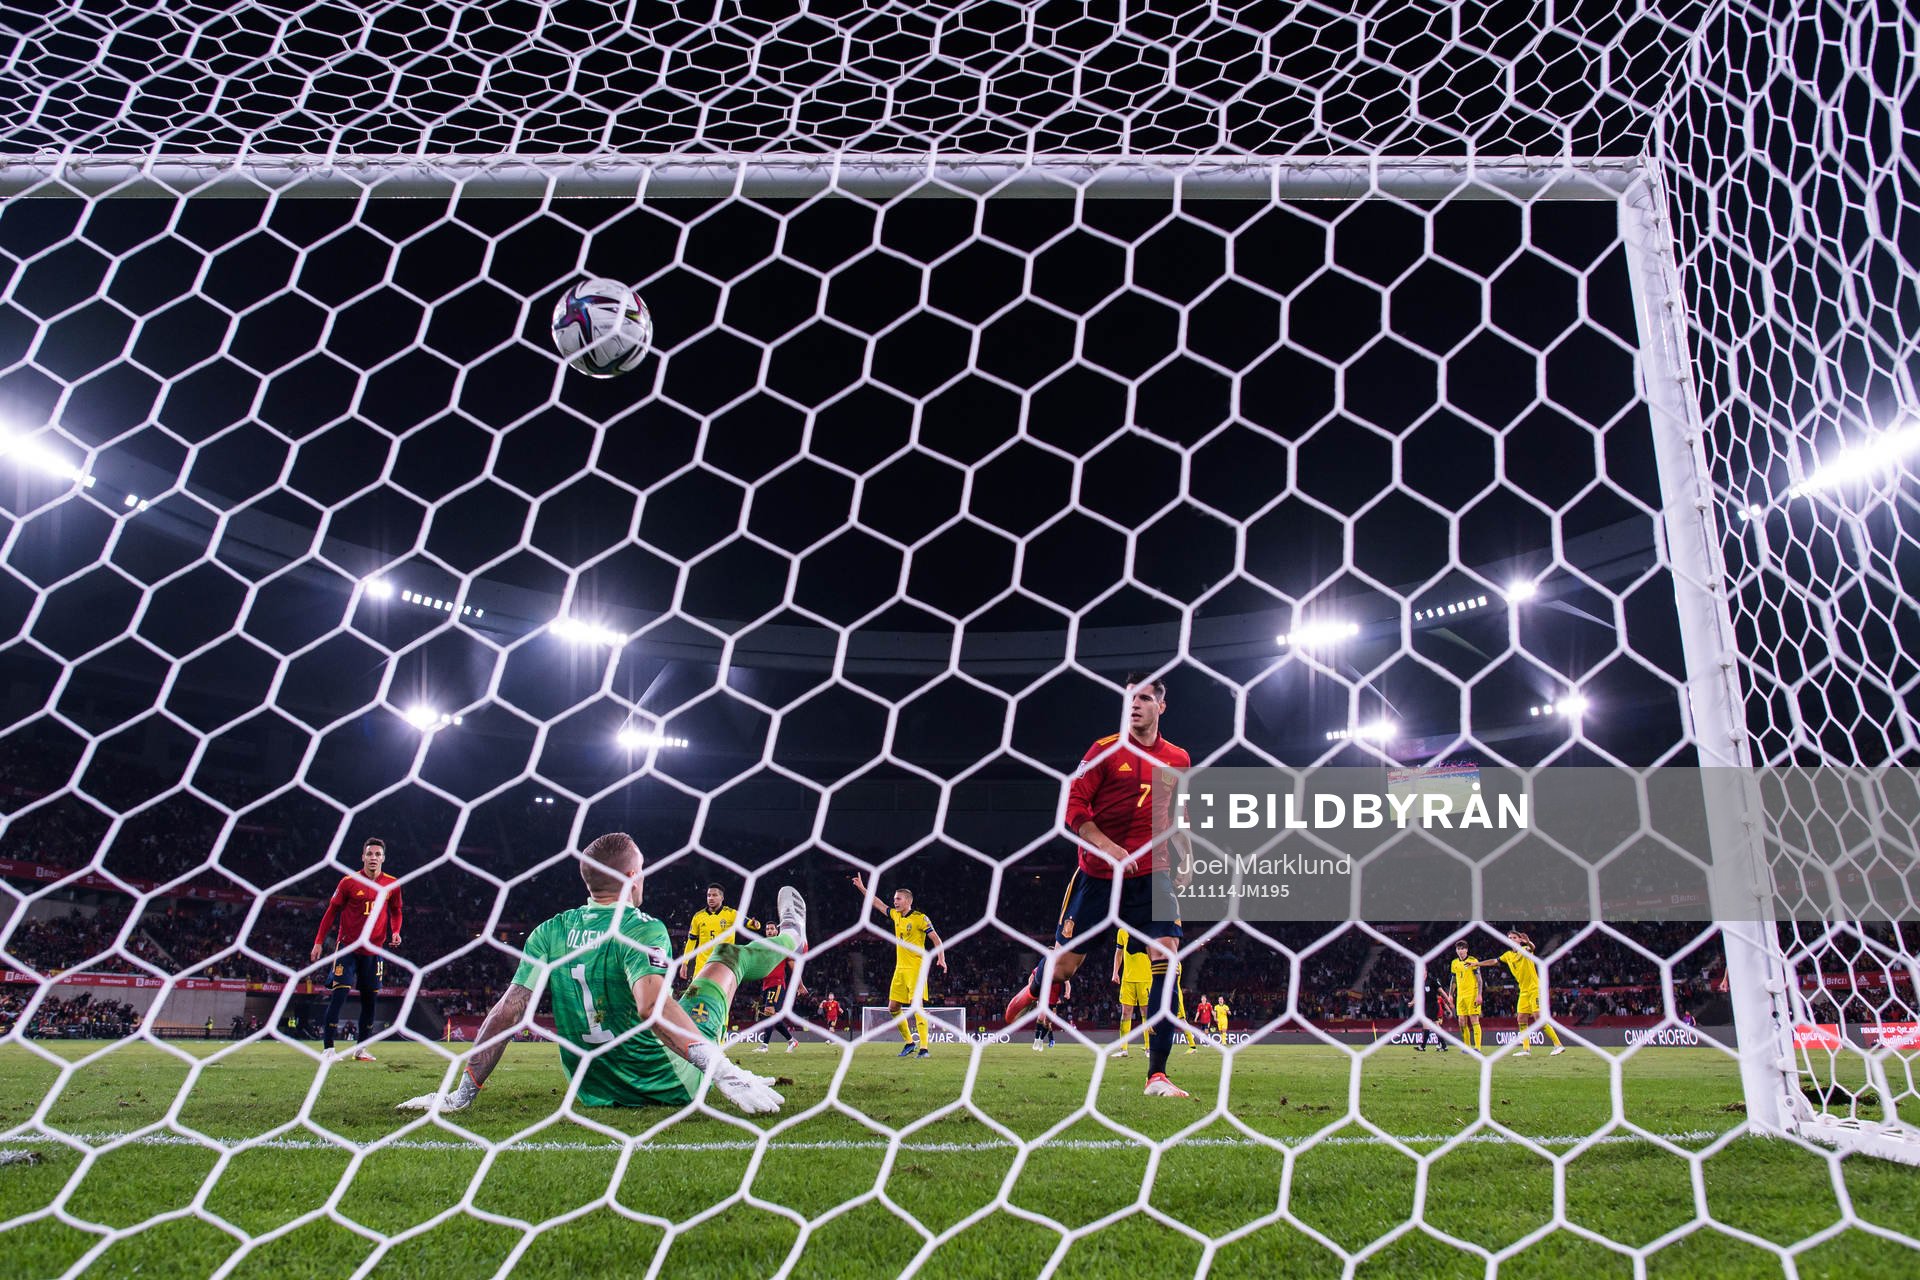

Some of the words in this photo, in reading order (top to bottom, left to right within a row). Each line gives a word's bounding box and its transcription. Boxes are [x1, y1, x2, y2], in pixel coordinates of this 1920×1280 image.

[1137, 784, 1151, 808] 7
[571, 964, 615, 1044] 1
[767, 991, 776, 1000] 17
[1624, 1030, 1657, 1045] CAVIAR
[1659, 1029, 1699, 1045] RIOFRIO
